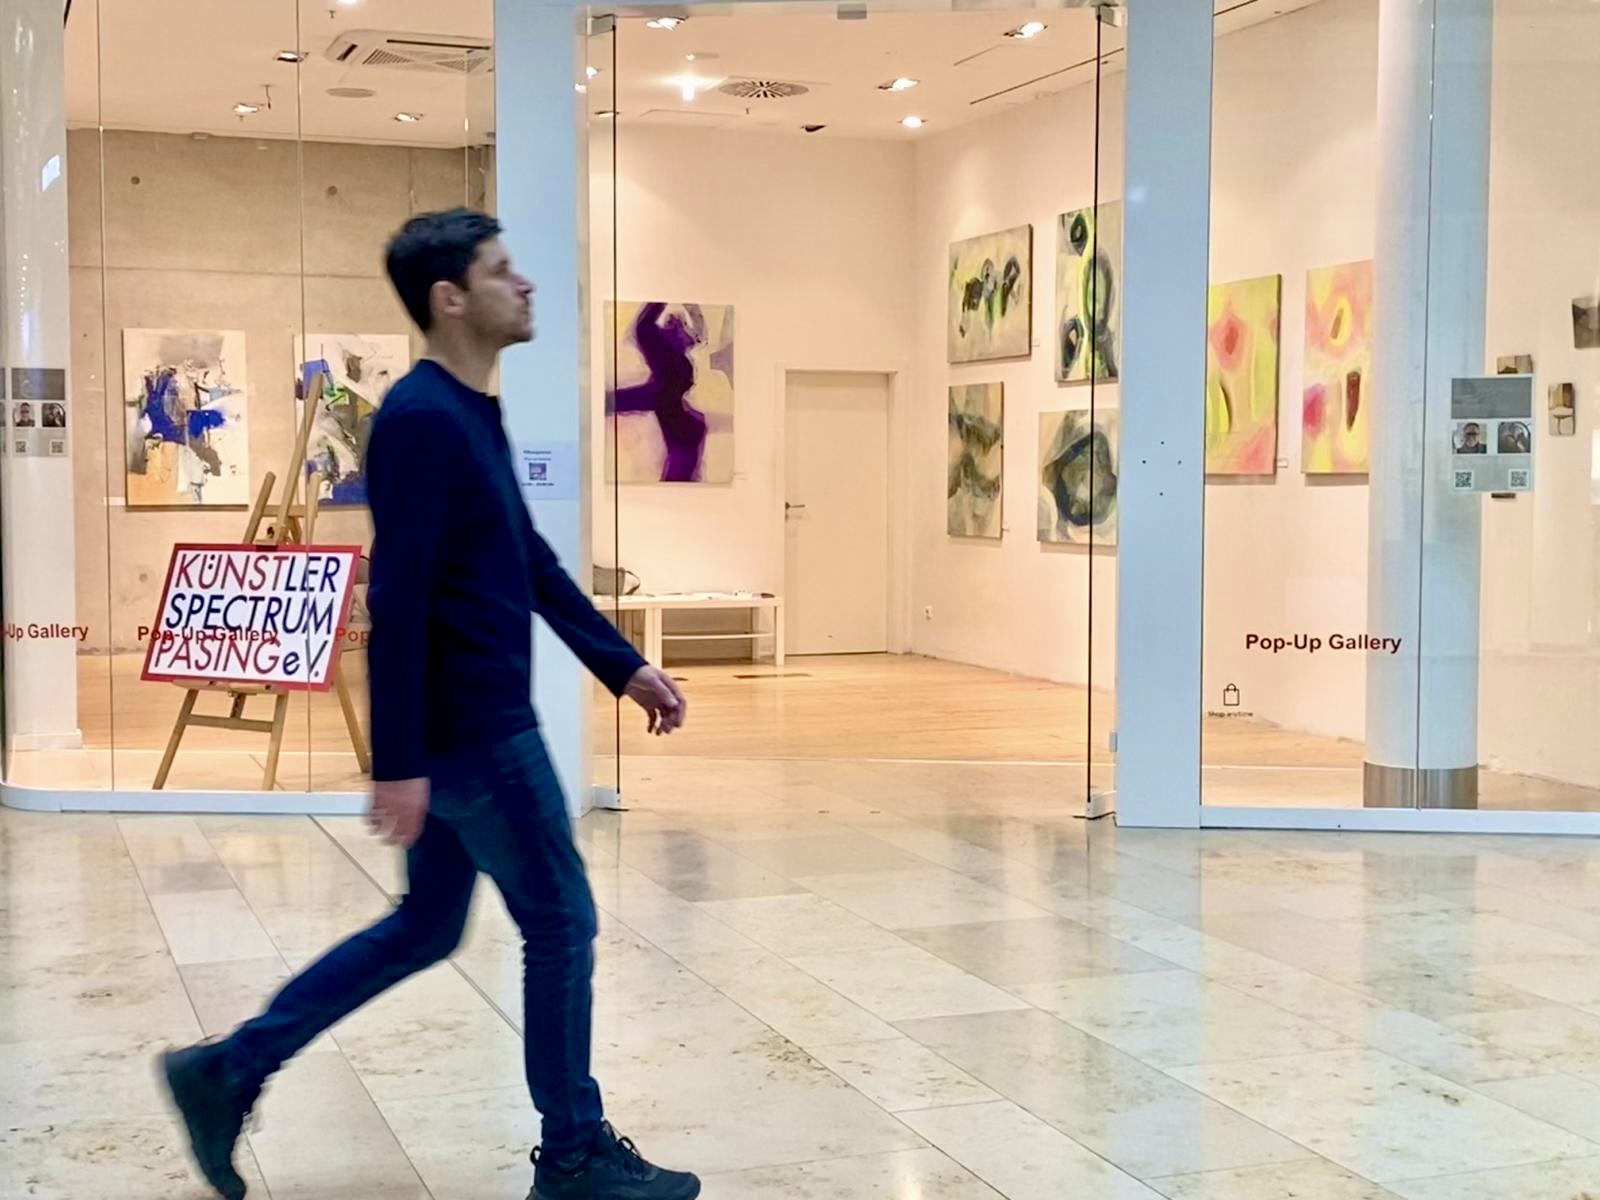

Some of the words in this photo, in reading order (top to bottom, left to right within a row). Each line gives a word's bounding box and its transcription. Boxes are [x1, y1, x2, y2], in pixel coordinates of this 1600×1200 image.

[174, 553, 341, 593] KÜNSTLER
[165, 592, 335, 635] SPECTRUM
[27, 623, 89, 642] Gallery
[212, 627, 279, 645] Gallery
[1245, 633, 1322, 653] Pop-Up
[1328, 633, 1402, 654] Gallery
